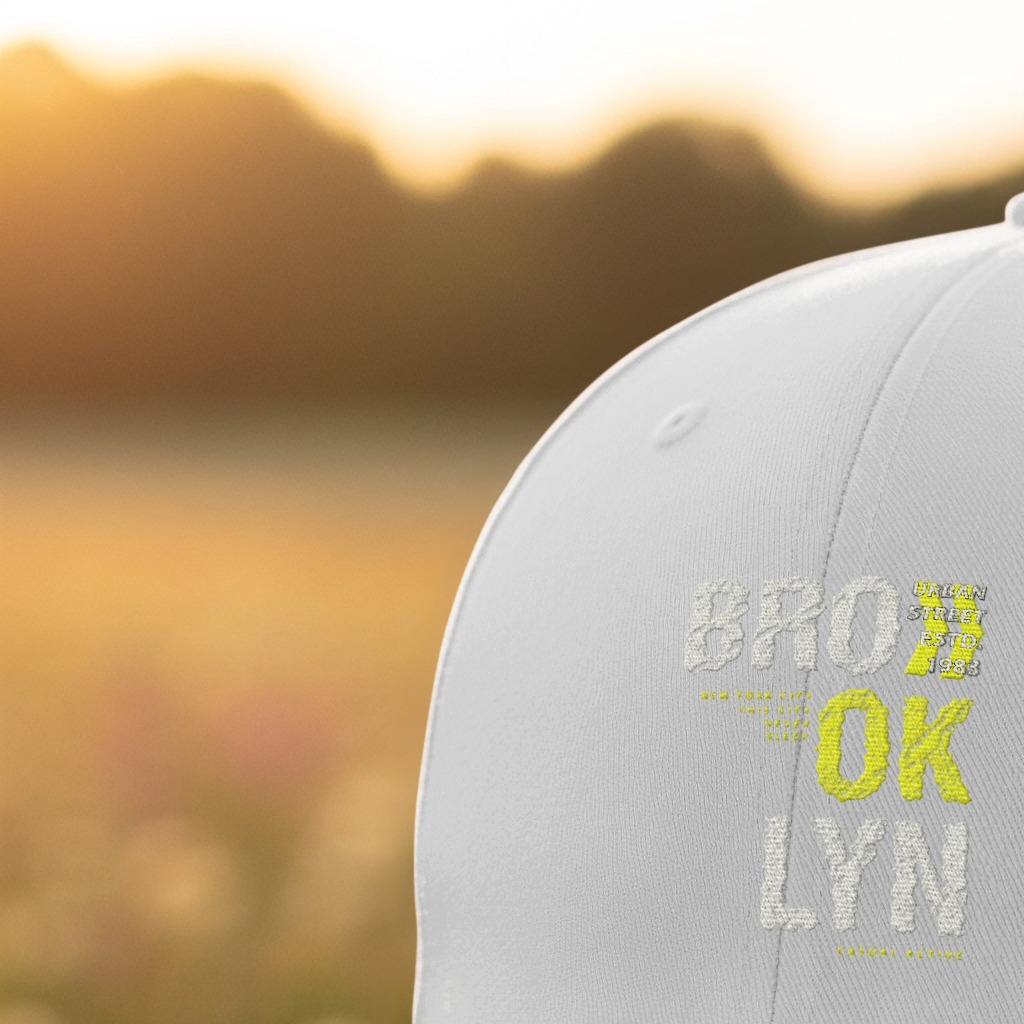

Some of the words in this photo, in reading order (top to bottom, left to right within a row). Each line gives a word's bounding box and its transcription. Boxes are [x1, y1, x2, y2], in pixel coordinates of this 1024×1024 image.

[912, 581, 987, 601] URBAN
[907, 605, 987, 624] STREET
[684, 576, 902, 677] BRO
[928, 657, 981, 677] 1983
[700, 690, 729, 701] NEW
[736, 690, 773, 701] YORK
[779, 691, 812, 701] CITY
[739, 705, 770, 714] THIS
[778, 705, 810, 715] CITY
[765, 731, 809, 742] SLEEP
[815, 688, 974, 805] OK
[760, 815, 970, 936] LYN
[837, 946, 896, 958] CASUAL
[906, 948, 963, 960] ACTIVE
